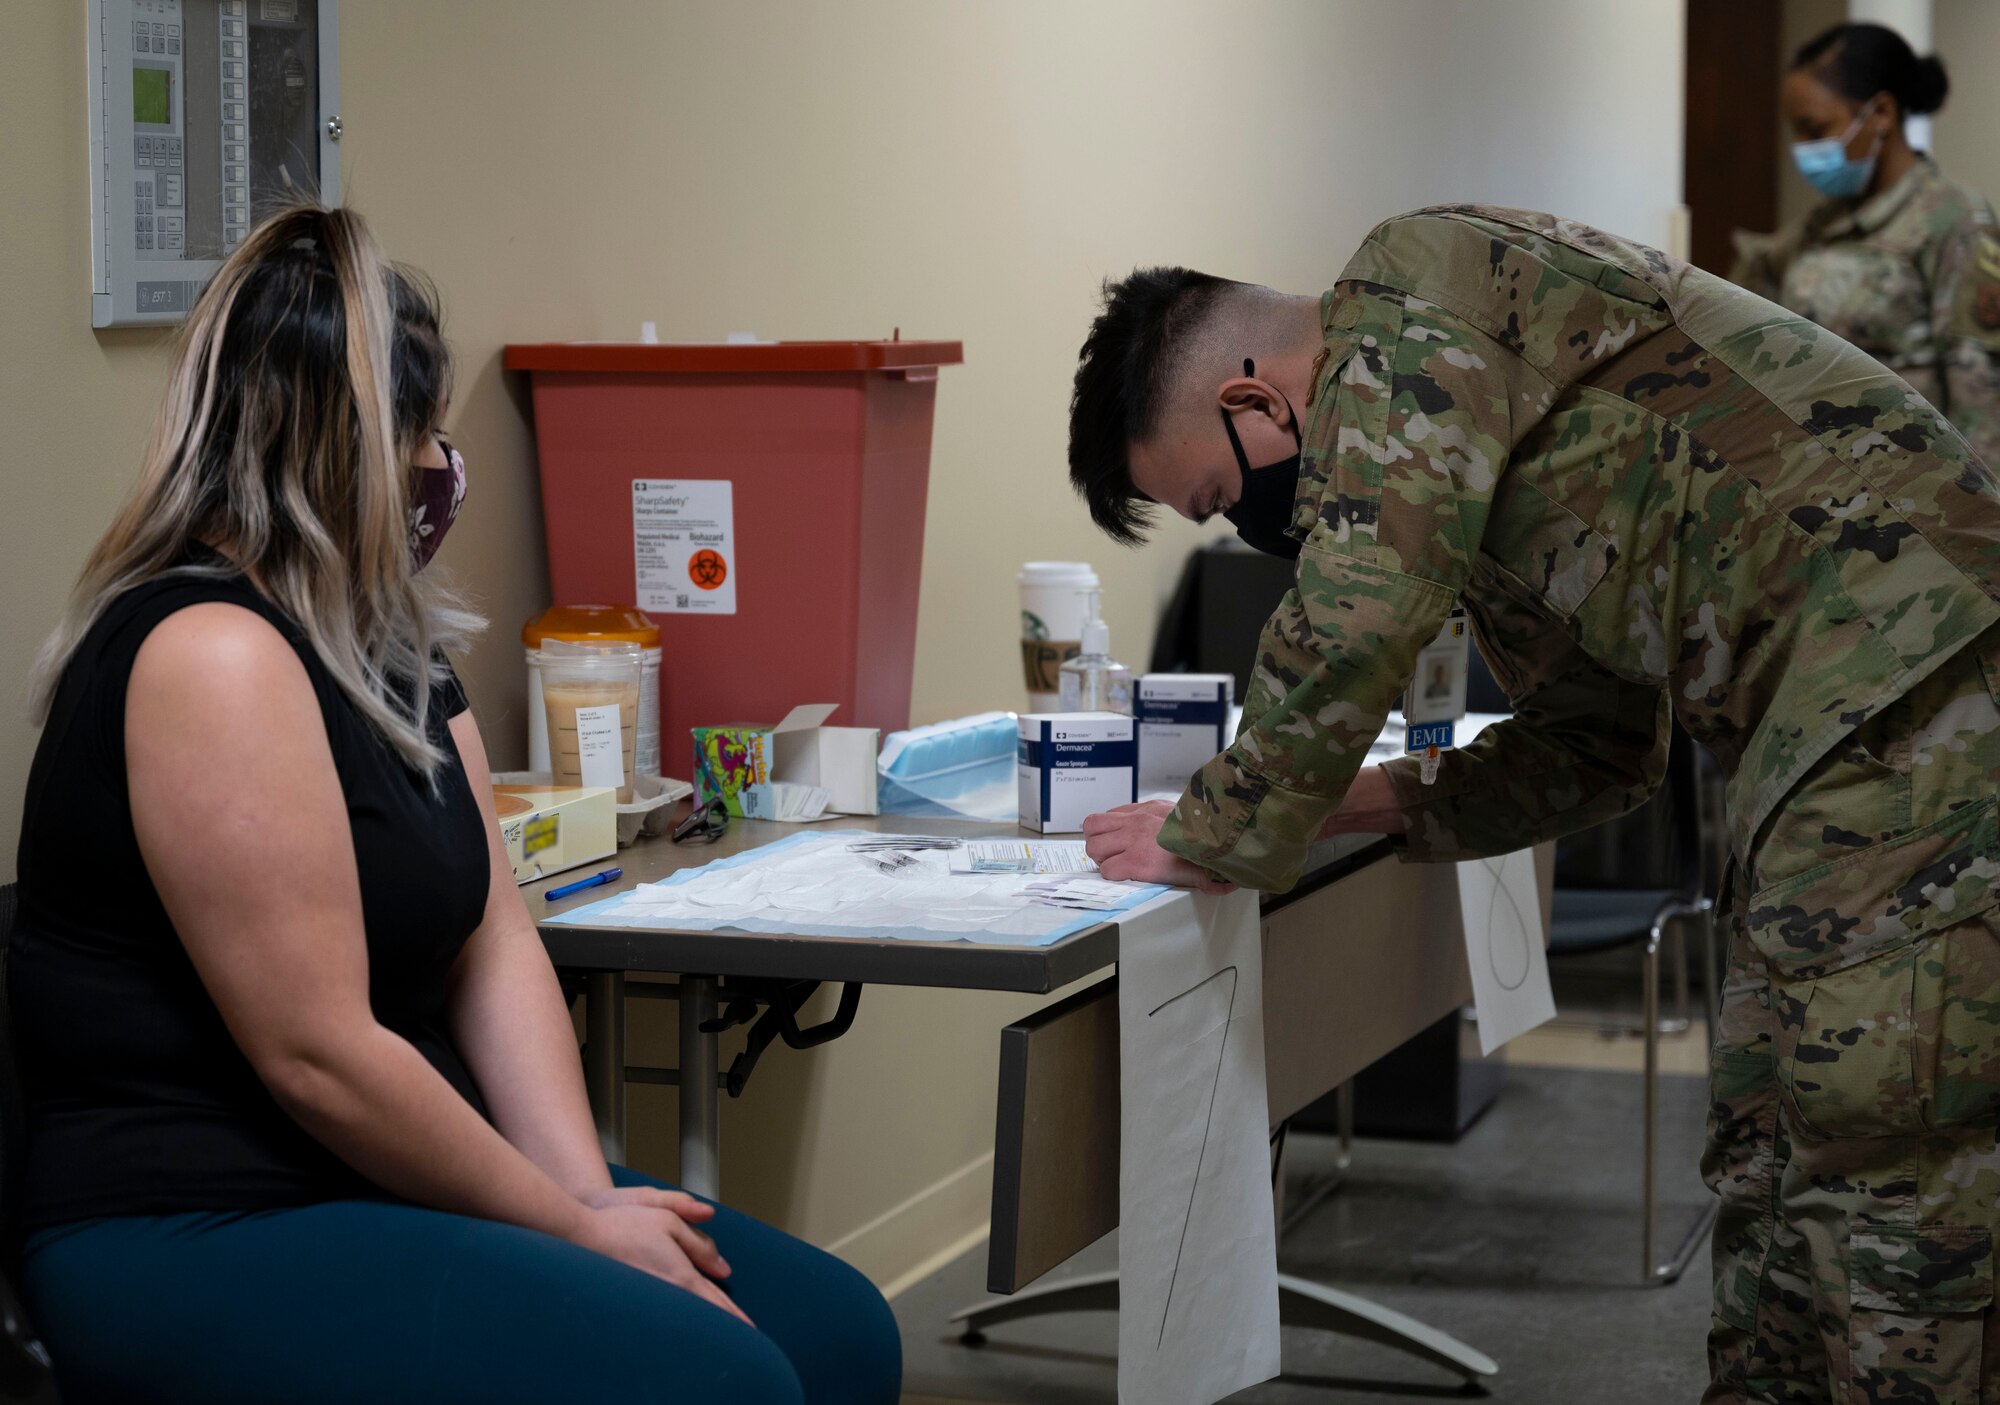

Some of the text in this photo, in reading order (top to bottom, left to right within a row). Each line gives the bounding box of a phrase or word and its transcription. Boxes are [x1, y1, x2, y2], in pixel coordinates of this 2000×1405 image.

[152, 290, 166, 303] EST
[689, 532, 724, 541] Biohazard
[1412, 725, 1450, 746] EMT
[1070, 760, 1088, 768] Sponges
[1147, 965, 1239, 1352] 7
